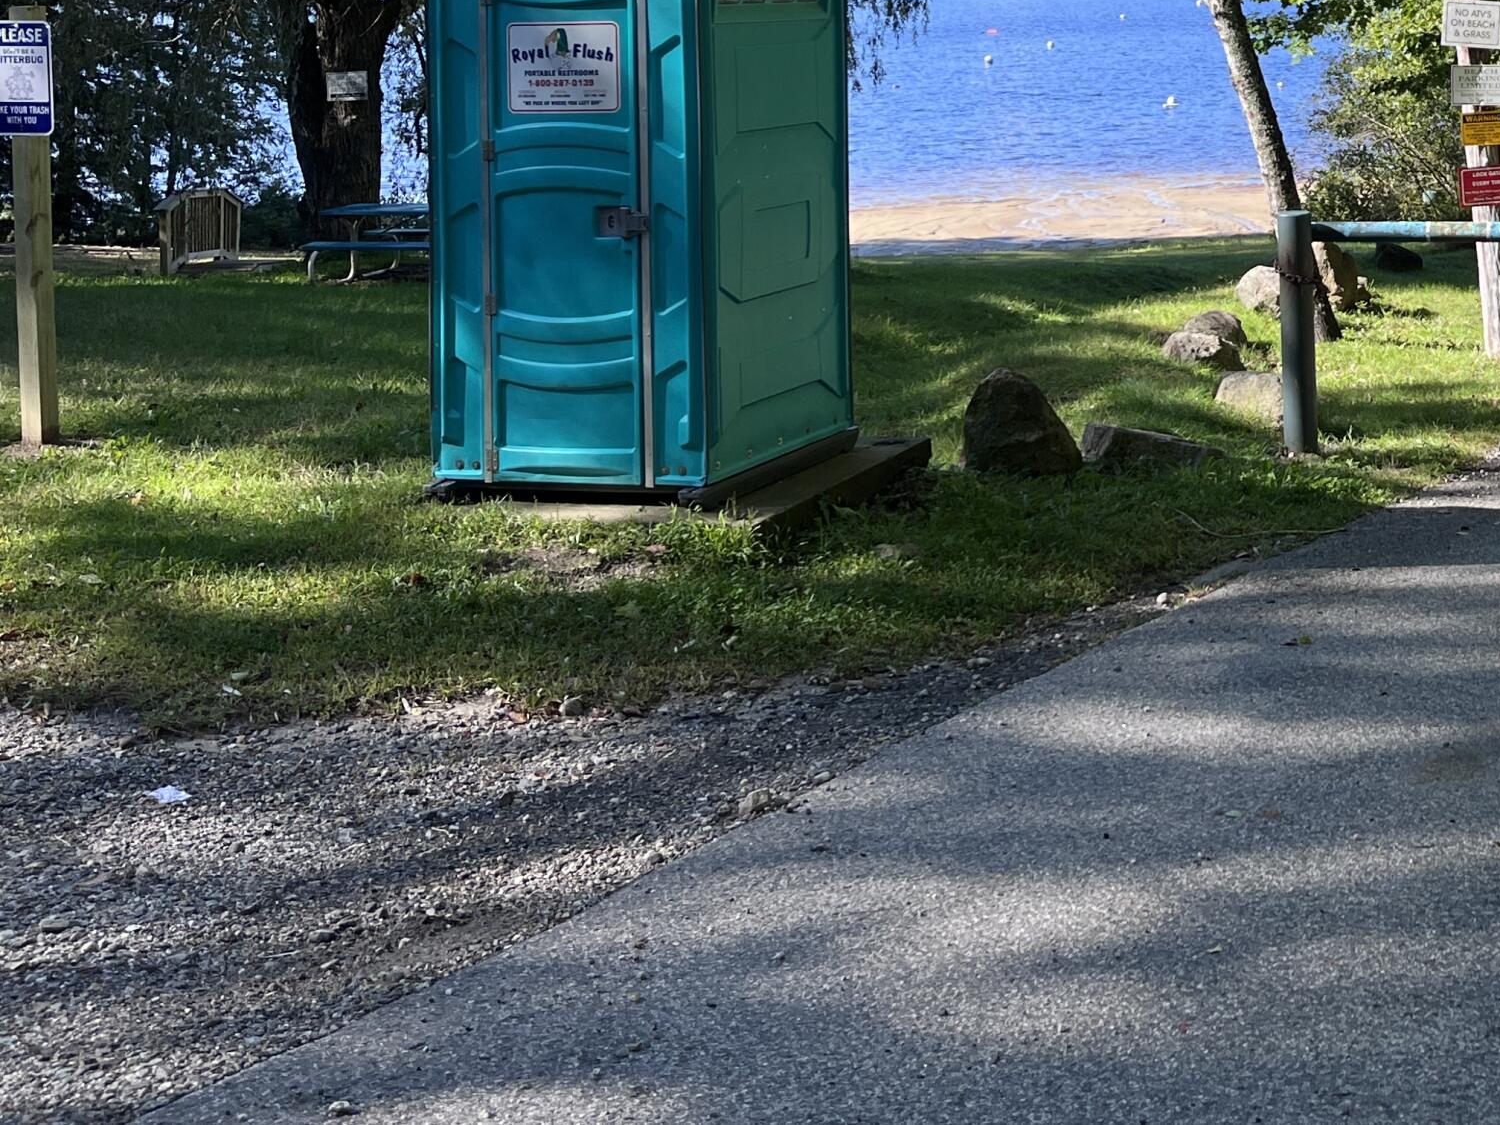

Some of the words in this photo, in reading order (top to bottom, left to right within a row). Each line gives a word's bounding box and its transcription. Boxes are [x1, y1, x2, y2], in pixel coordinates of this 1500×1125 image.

[1455, 8, 1469, 17] NO
[1471, 10, 1492, 18] ATV'S
[1450, 19, 1465, 27] ON
[1467, 20, 1496, 29] BEACH
[0, 27, 43, 43] LEASE
[1463, 29, 1491, 39] GRASS
[511, 45, 549, 64] Royal
[572, 43, 614, 62] Flush
[0, 55, 43, 64] ITTERBUG
[10, 105, 28, 114] YOUR
[29, 105, 50, 115] TRASH
[6, 116, 22, 124] WITH
[24, 116, 37, 124] YOU
